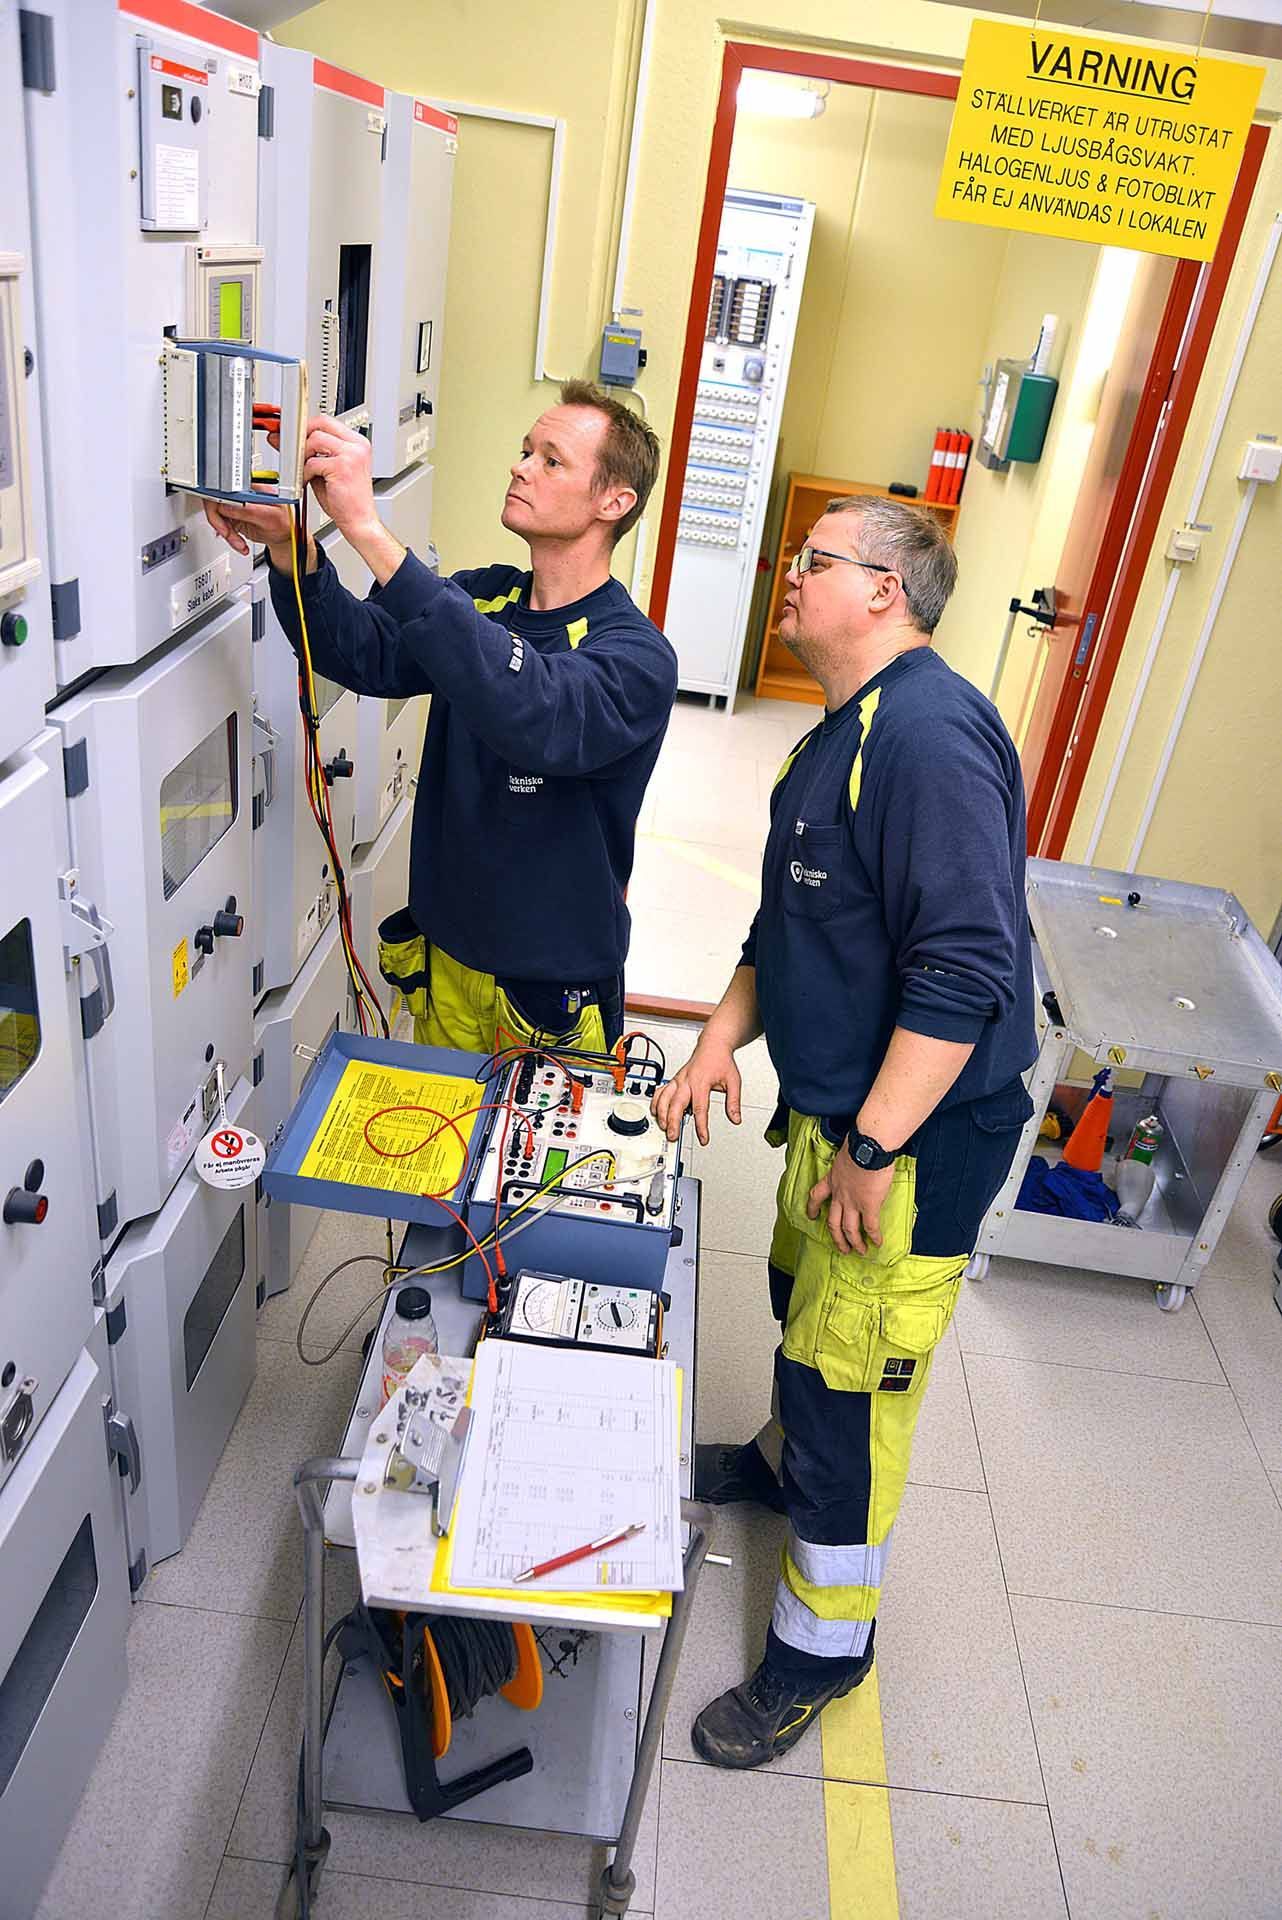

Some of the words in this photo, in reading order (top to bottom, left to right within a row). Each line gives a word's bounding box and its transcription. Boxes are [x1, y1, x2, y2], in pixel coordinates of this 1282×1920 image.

[1031, 41, 1198, 99] VARNING
[971, 89, 1098, 128] STÄLLVERKET
[1103, 112, 1129, 132] ÄR
[1136, 117, 1233, 149] UTRUSTAT
[990, 125, 1034, 148] MED
[1041, 134, 1196, 176] LJUSBÅGSVAKT.
[952, 176, 987, 203] FÅR
[992, 188, 1013, 208] EJ
[1018, 192, 1112, 225] ANVÄNDAS
[1118, 207, 1123, 225] I
[1128, 211, 1207, 240] LOKALEN
[959, 152, 1090, 190] HALOGENLJUS
[1097, 174, 1107, 192] &
[1115, 177, 1216, 210] FOTOBLIXT
[509, 785, 537, 793] verken
